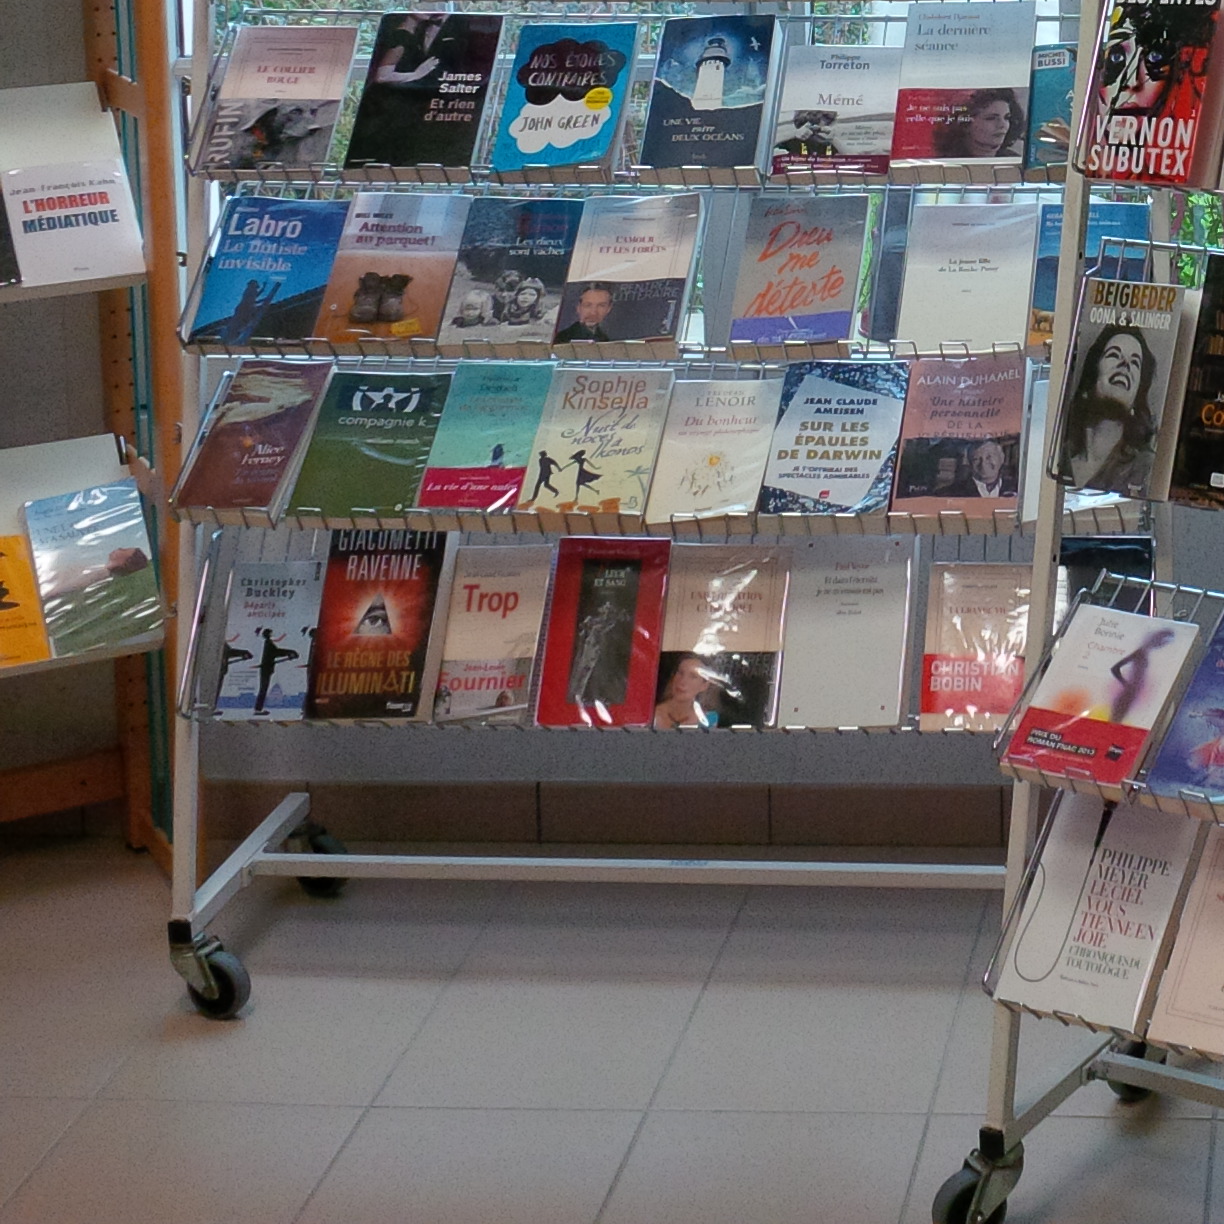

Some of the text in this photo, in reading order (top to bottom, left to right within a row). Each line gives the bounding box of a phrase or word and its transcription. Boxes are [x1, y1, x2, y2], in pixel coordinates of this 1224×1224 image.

[530, 53, 557, 69] NOS
[819, 59, 870, 71] Torreton
[1036, 55, 1067, 68] BUSSI
[438, 71, 481, 82] James
[439, 83, 480, 94] Salter
[429, 98, 475, 109] Et rien
[817, 93, 864, 106] Mémé
[424, 110, 472, 122] d'autre
[518, 113, 600, 133] JOHN GREEN
[207, 103, 245, 168] RUFIN
[1096, 115, 1195, 148] VERNON
[1087, 146, 1190, 176] SUBUTEX
[23, 192, 110, 214] L'HORREUR
[22, 209, 119, 234] MÉDIATIQUE
[228, 212, 303, 238] Labro
[1093, 282, 1177, 312] BEIGBEDER
[1090, 308, 1171, 331] OONA & SALINGER
[573, 376, 647, 397] Sophie
[960, 369, 1021, 388] DUHAMEL
[695, 395, 757, 407] LENOIR
[804, 397, 878, 406] JEAN CLAUDE
[813, 406, 865, 415] AMEISEN
[799, 420, 869, 433] SUR LES
[794, 432, 869, 447] ÉPAULES
[777, 449, 882, 461] DE DARWIN
[346, 554, 422, 580] RAVENNE
[462, 584, 520, 618] Trop
[931, 661, 1019, 676] CHRISTIAN
[930, 677, 982, 692] BOBIN
[1030, 728, 1062, 742] PRIX DU
[1100, 848, 1174, 878] PHILIPPE
[1086, 896, 1126, 917] VOUS
[1073, 929, 1107, 949] JOIE
